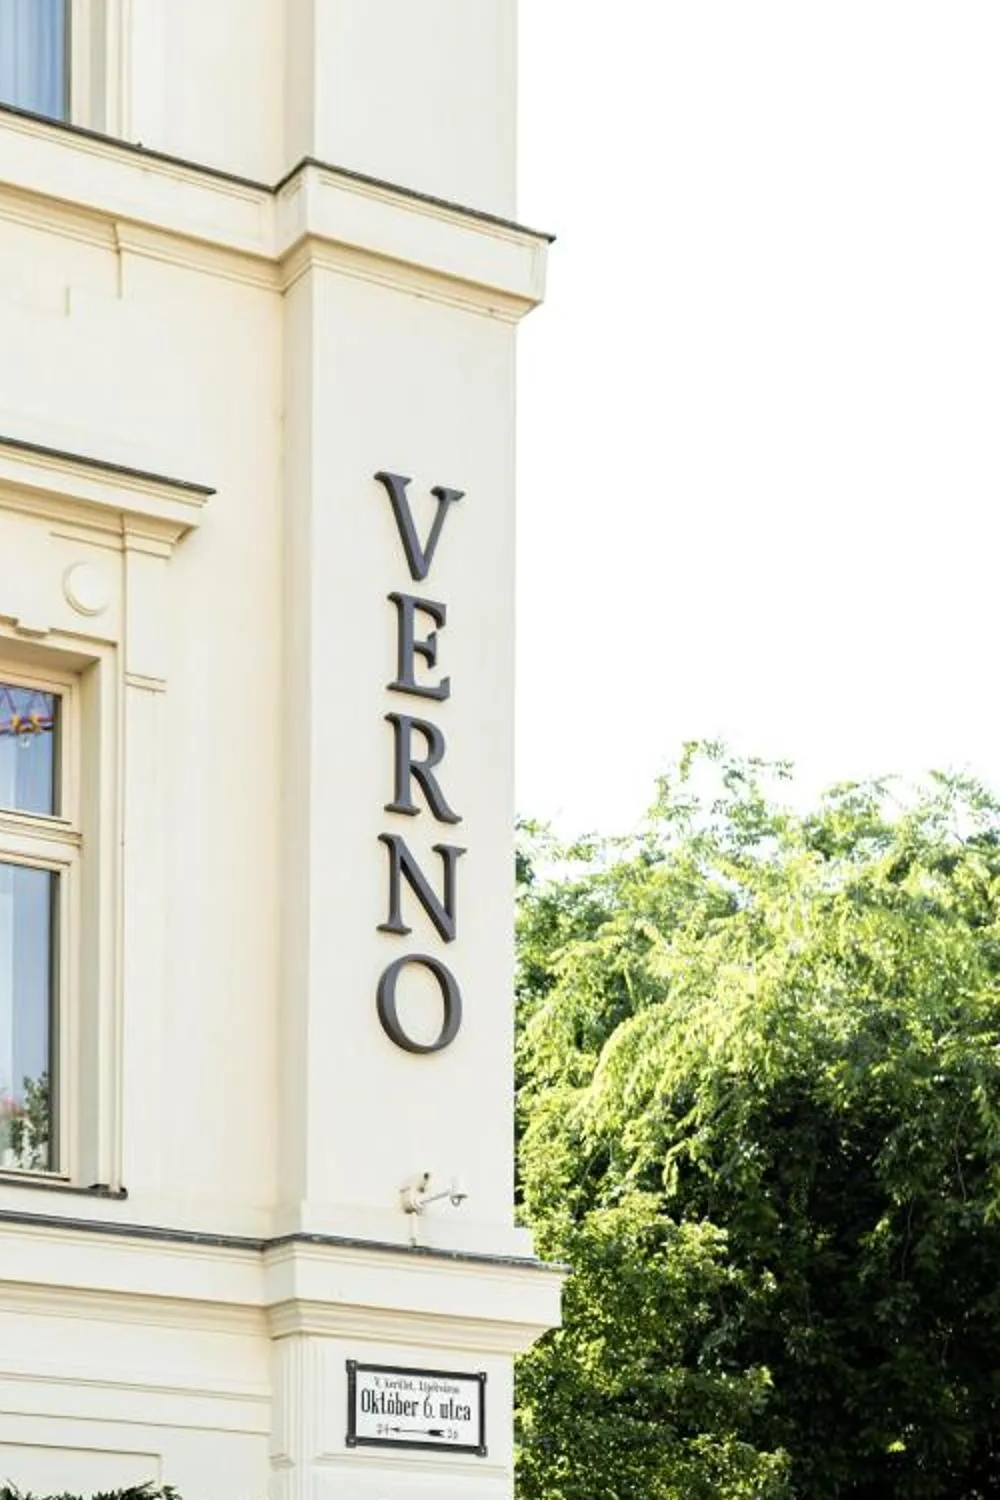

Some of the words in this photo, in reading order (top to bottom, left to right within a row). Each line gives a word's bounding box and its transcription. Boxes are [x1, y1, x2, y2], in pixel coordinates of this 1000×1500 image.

[374, 470, 467, 1055] VERNO
[361, 1387, 419, 1417] Október
[423, 1395, 436, 1419] 6.
